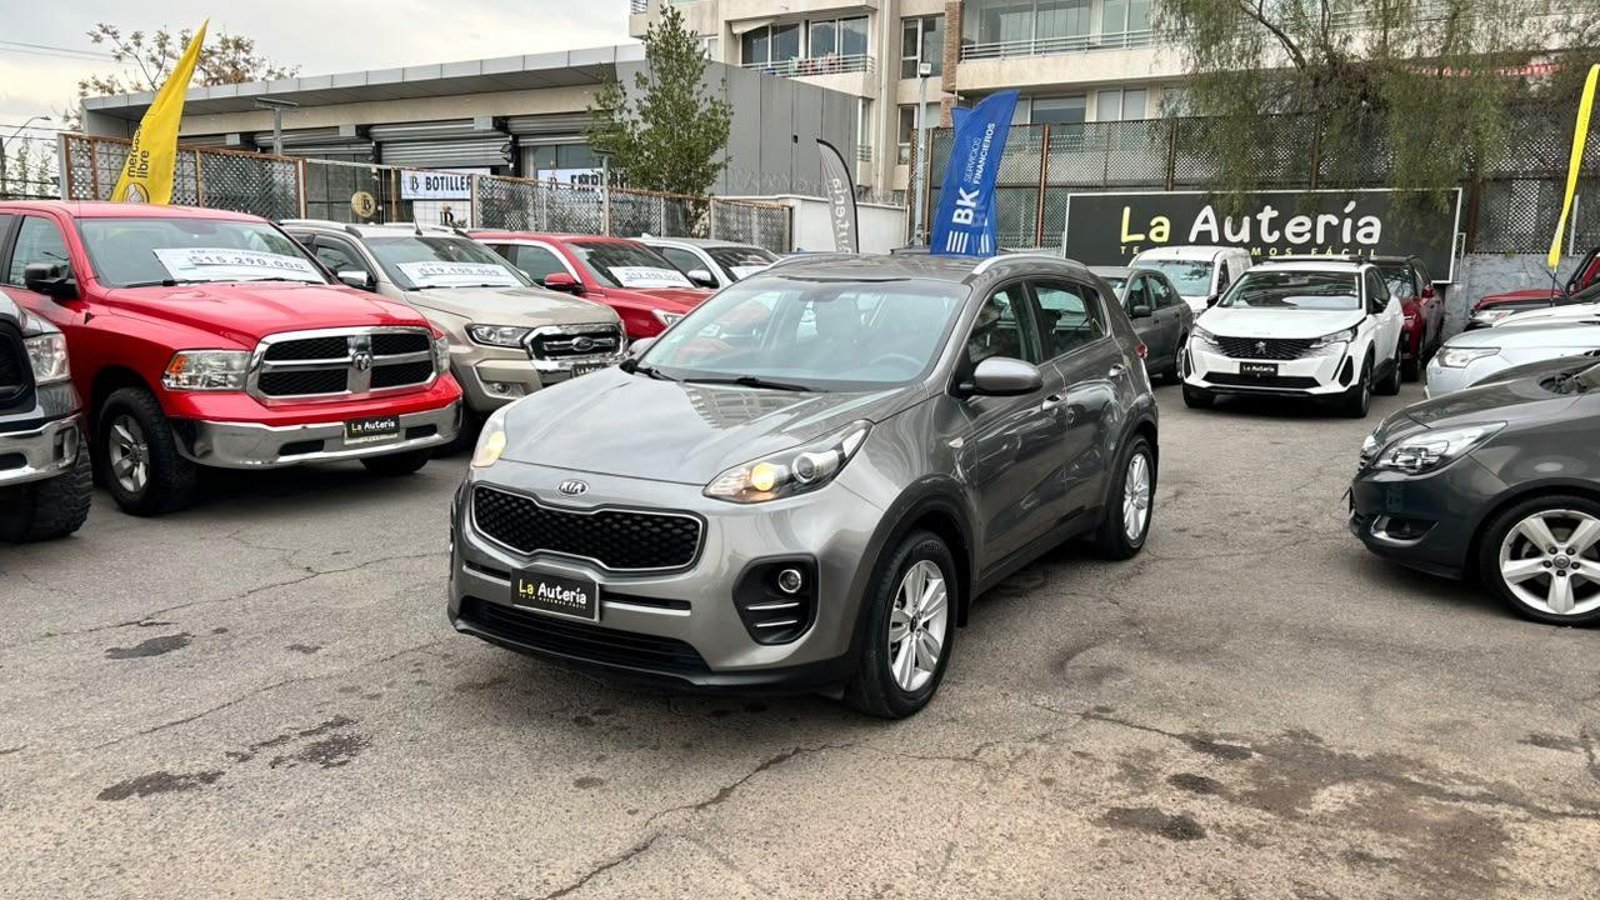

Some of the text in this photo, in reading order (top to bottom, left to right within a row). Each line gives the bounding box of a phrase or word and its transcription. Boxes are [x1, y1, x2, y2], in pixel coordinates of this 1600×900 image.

[137, 150, 150, 179] libre
[964, 137, 982, 183] SERVICIOS
[973, 122, 996, 185] FINANCIEROS
[951, 186, 980, 225] BK
[1120, 200, 1382, 245] La Autería
[1120, 246, 1140, 255] TE
[1310, 244, 1376, 257] FÁCIL
[351, 423, 362, 431] La
[560, 481, 582, 493] KIA
[519, 578, 534, 595] La
[537, 582, 587, 605] Autería
